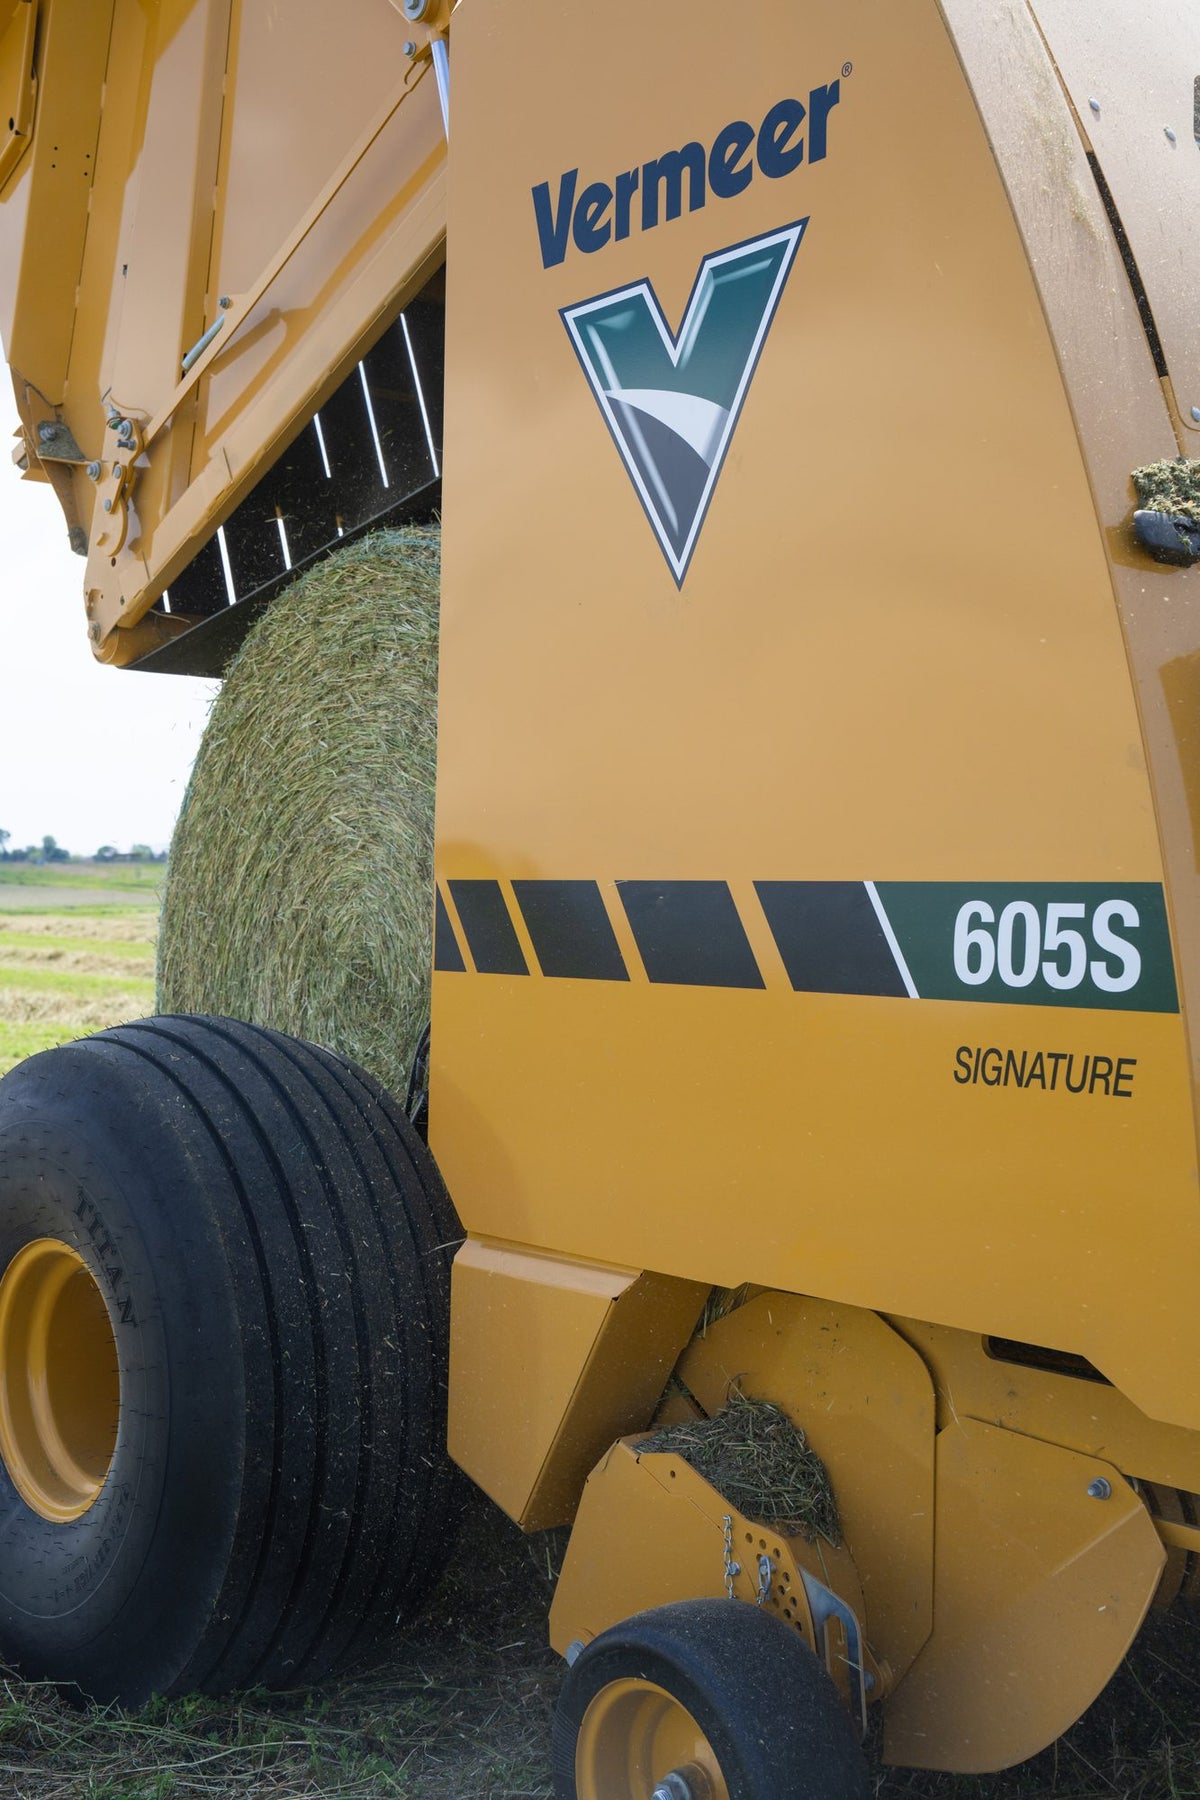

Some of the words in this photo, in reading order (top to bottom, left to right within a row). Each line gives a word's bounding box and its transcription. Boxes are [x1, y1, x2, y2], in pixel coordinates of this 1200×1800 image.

[531, 78, 840, 270] Vermeer
[953, 899, 1141, 992] 605S
[953, 1046, 1137, 1097] SIGNATURE
